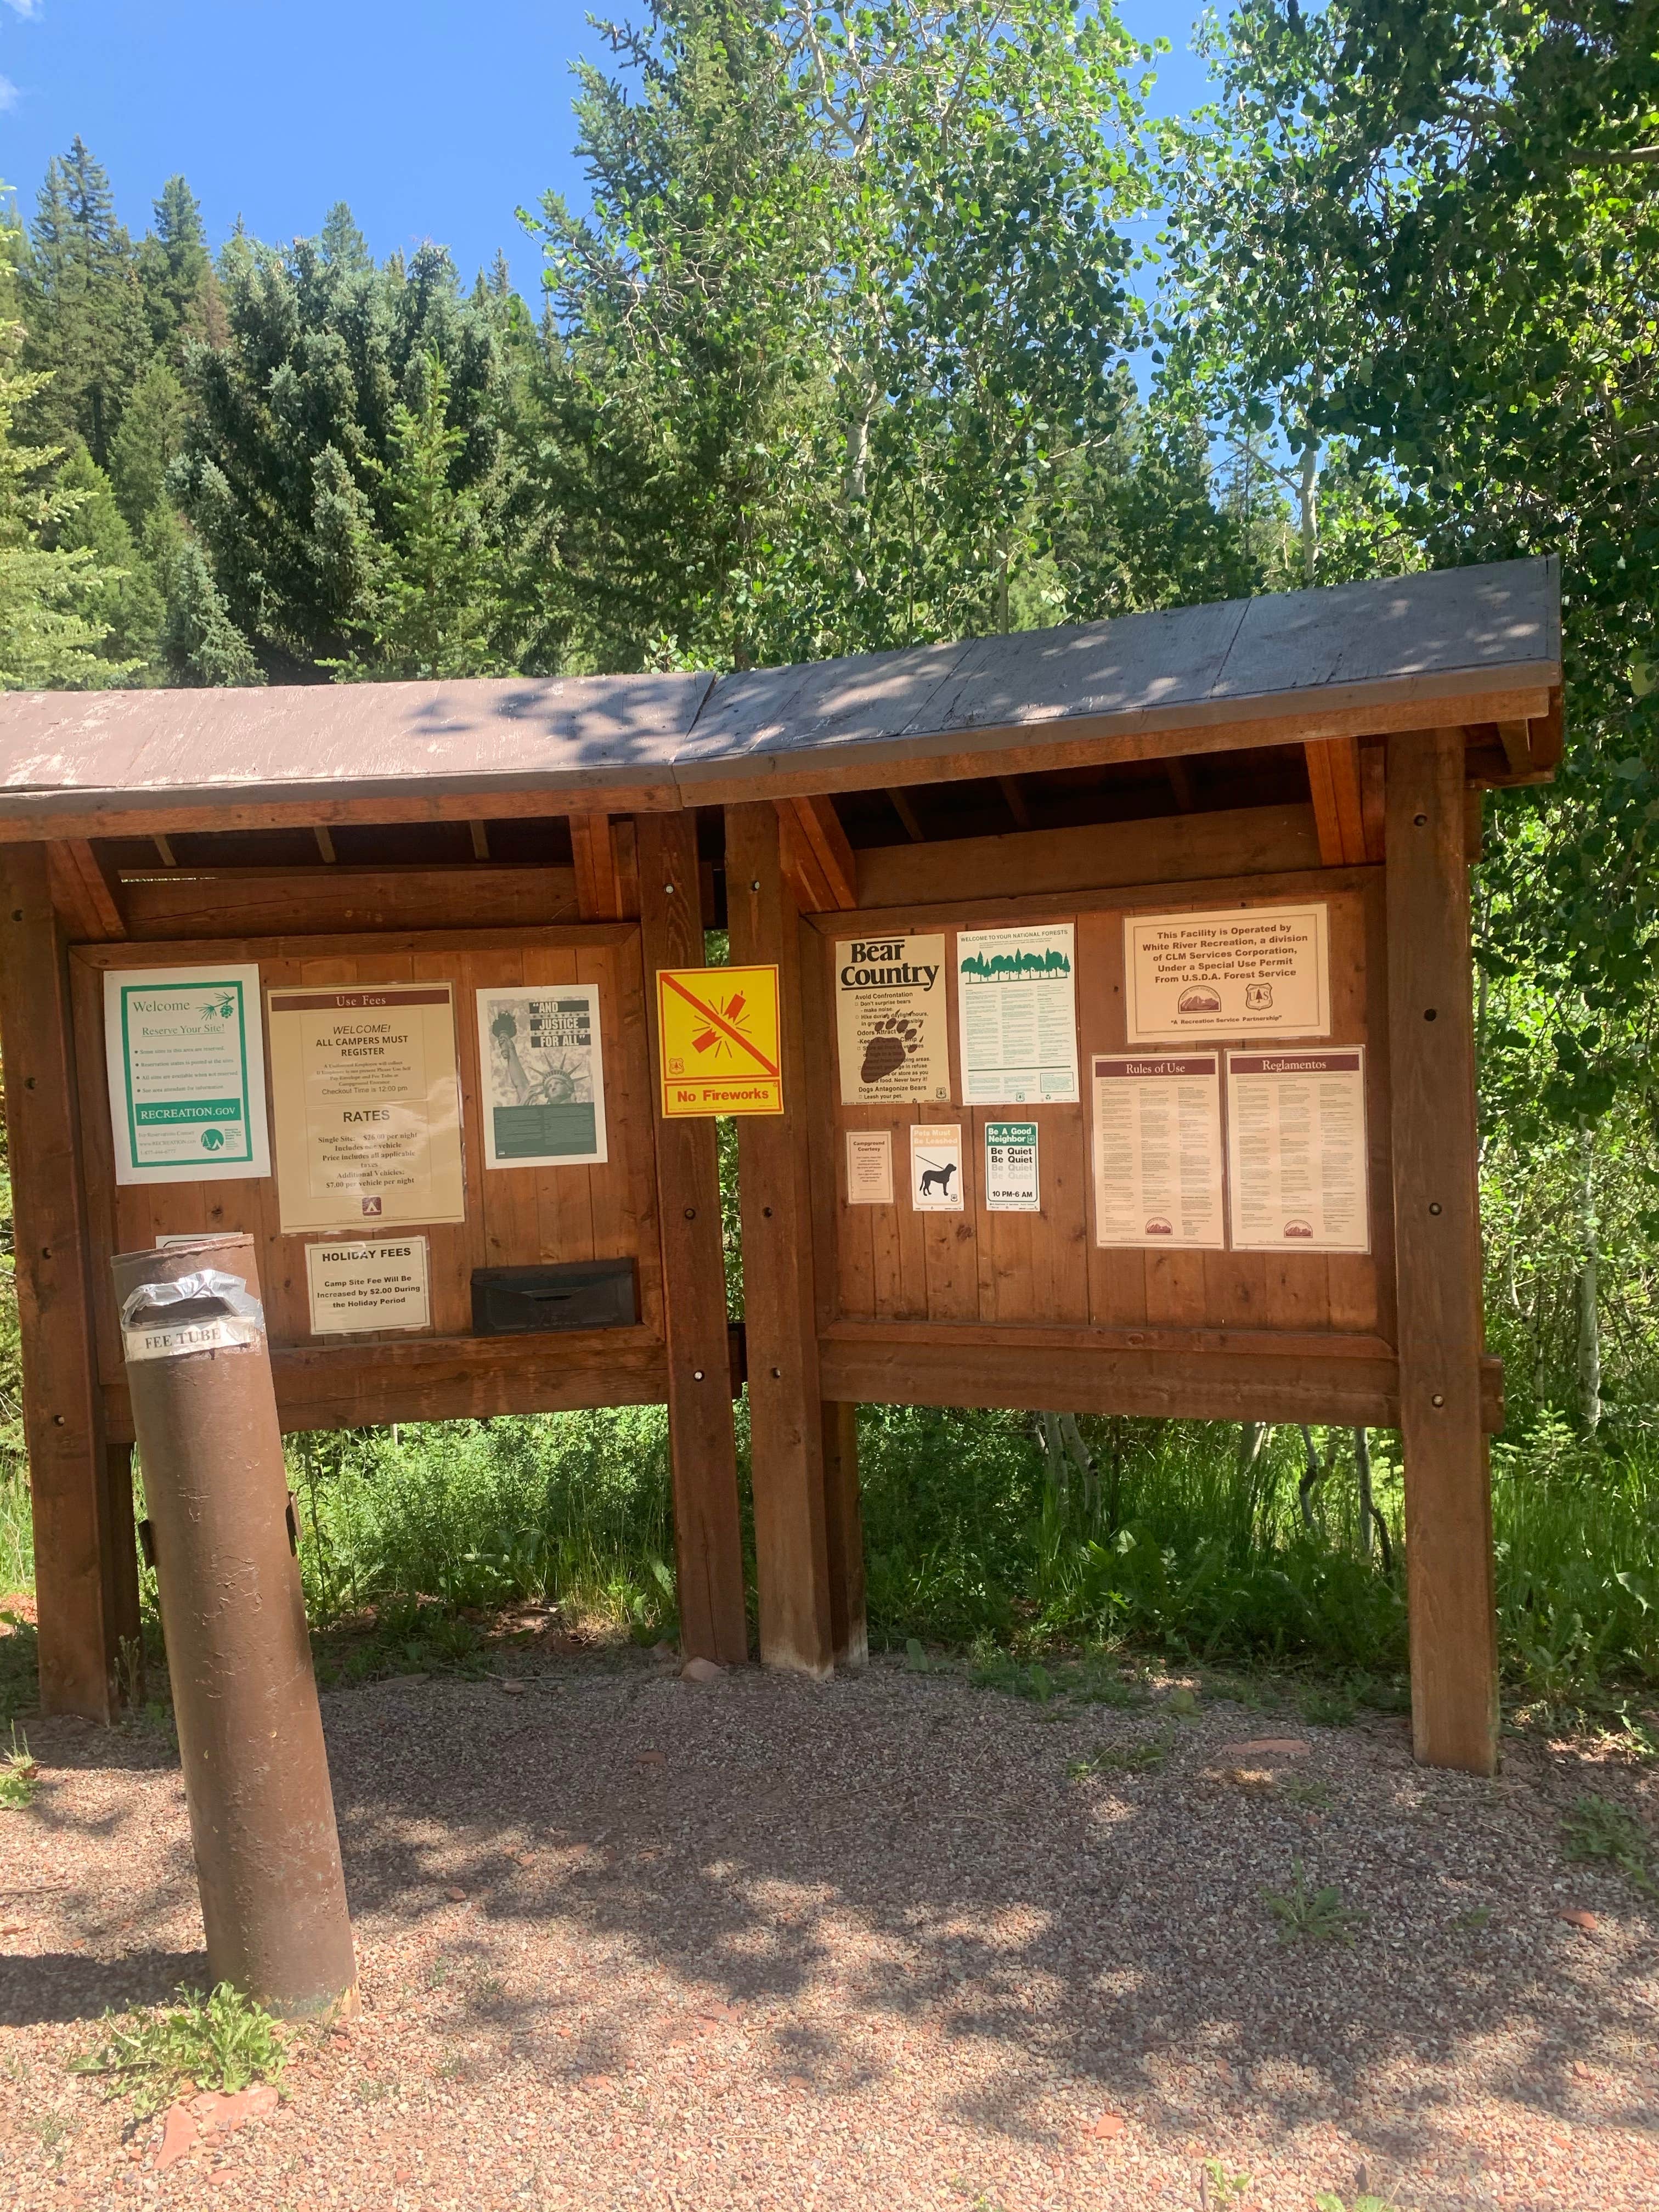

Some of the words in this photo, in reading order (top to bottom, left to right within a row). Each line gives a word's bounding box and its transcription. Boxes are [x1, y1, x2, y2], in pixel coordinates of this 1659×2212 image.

[1181, 929, 1216, 938] Facility
[1231, 924, 1277, 935] Operated
[1280, 924, 1291, 933] by
[1200, 938, 1256, 947] Recreation,
[1269, 934, 1307, 943] division
[850, 943, 905, 963] Bear
[1189, 950, 1232, 959] Services
[1235, 946, 1297, 957] Corporation,
[1158, 964, 1187, 972] Under
[1198, 961, 1234, 971] Special
[1260, 957, 1293, 966] Permit
[841, 962, 940, 992] Country
[1182, 973, 1221, 981] U.S.D.A.
[1224, 971, 1255, 979] Forest
[1258, 969, 1296, 978] Service
[132, 1000, 190, 1013] Welcome
[336, 996, 357, 1006] Use
[362, 995, 386, 1006] Fees
[142, 1027, 178, 1035] Reserve
[180, 1025, 202, 1034] Your
[204, 1023, 224, 1032] Site!
[333, 1024, 391, 1034] WELCOME!
[539, 1018, 579, 1030] JUSTICE
[336, 1037, 380, 1046] CAMPERS
[382, 1035, 408, 1043] MUST
[540, 1036, 559, 1047] FOR
[341, 1047, 385, 1057] REGISTER
[1126, 1064, 1152, 1074] Rules
[1154, 1063, 1165, 1073] of
[1167, 1062, 1186, 1073] Use
[1262, 1059, 1327, 1072] Reglamentos
[677, 1091, 696, 1102] No
[702, 1087, 769, 1102] Fireworks
[140, 1107, 235, 1119] RECREATION.GOV
[343, 1110, 390, 1122] RATES
[988, 1135, 1026, 1143] Neighbor
[381, 1150, 415, 1159] applicable
[322, 1250, 376, 1262] HOLIDAY
[380, 1248, 411, 1257] FEES
[317, 1290, 356, 1298] Increased
[145, 1335, 172, 1349] FEE
[176, 1328, 221, 1345] TUBE
